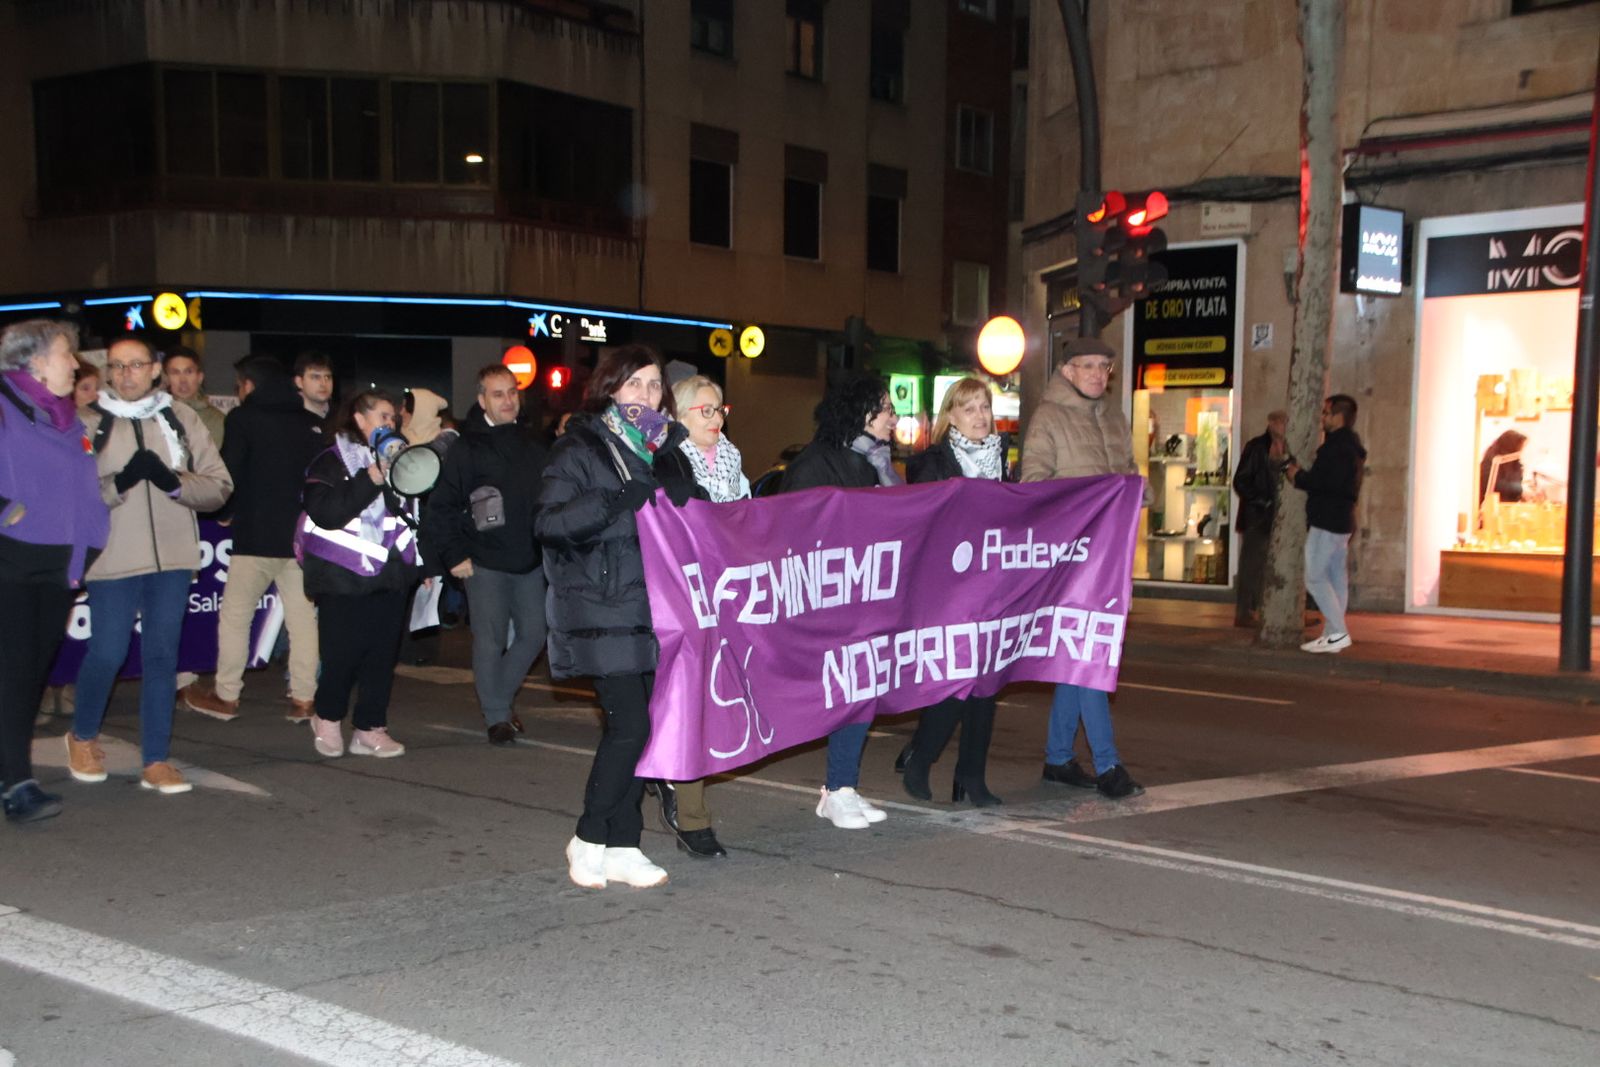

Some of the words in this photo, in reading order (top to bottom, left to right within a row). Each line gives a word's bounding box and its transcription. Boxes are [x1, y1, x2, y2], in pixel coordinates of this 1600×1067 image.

[1152, 278, 1191, 293] OMPRA
[1191, 276, 1227, 291] VENTA
[1145, 299, 1159, 319] DE
[1161, 298, 1184, 319] ORO
[1184, 298, 1193, 318] Y
[1195, 296, 1228, 317] PLATA
